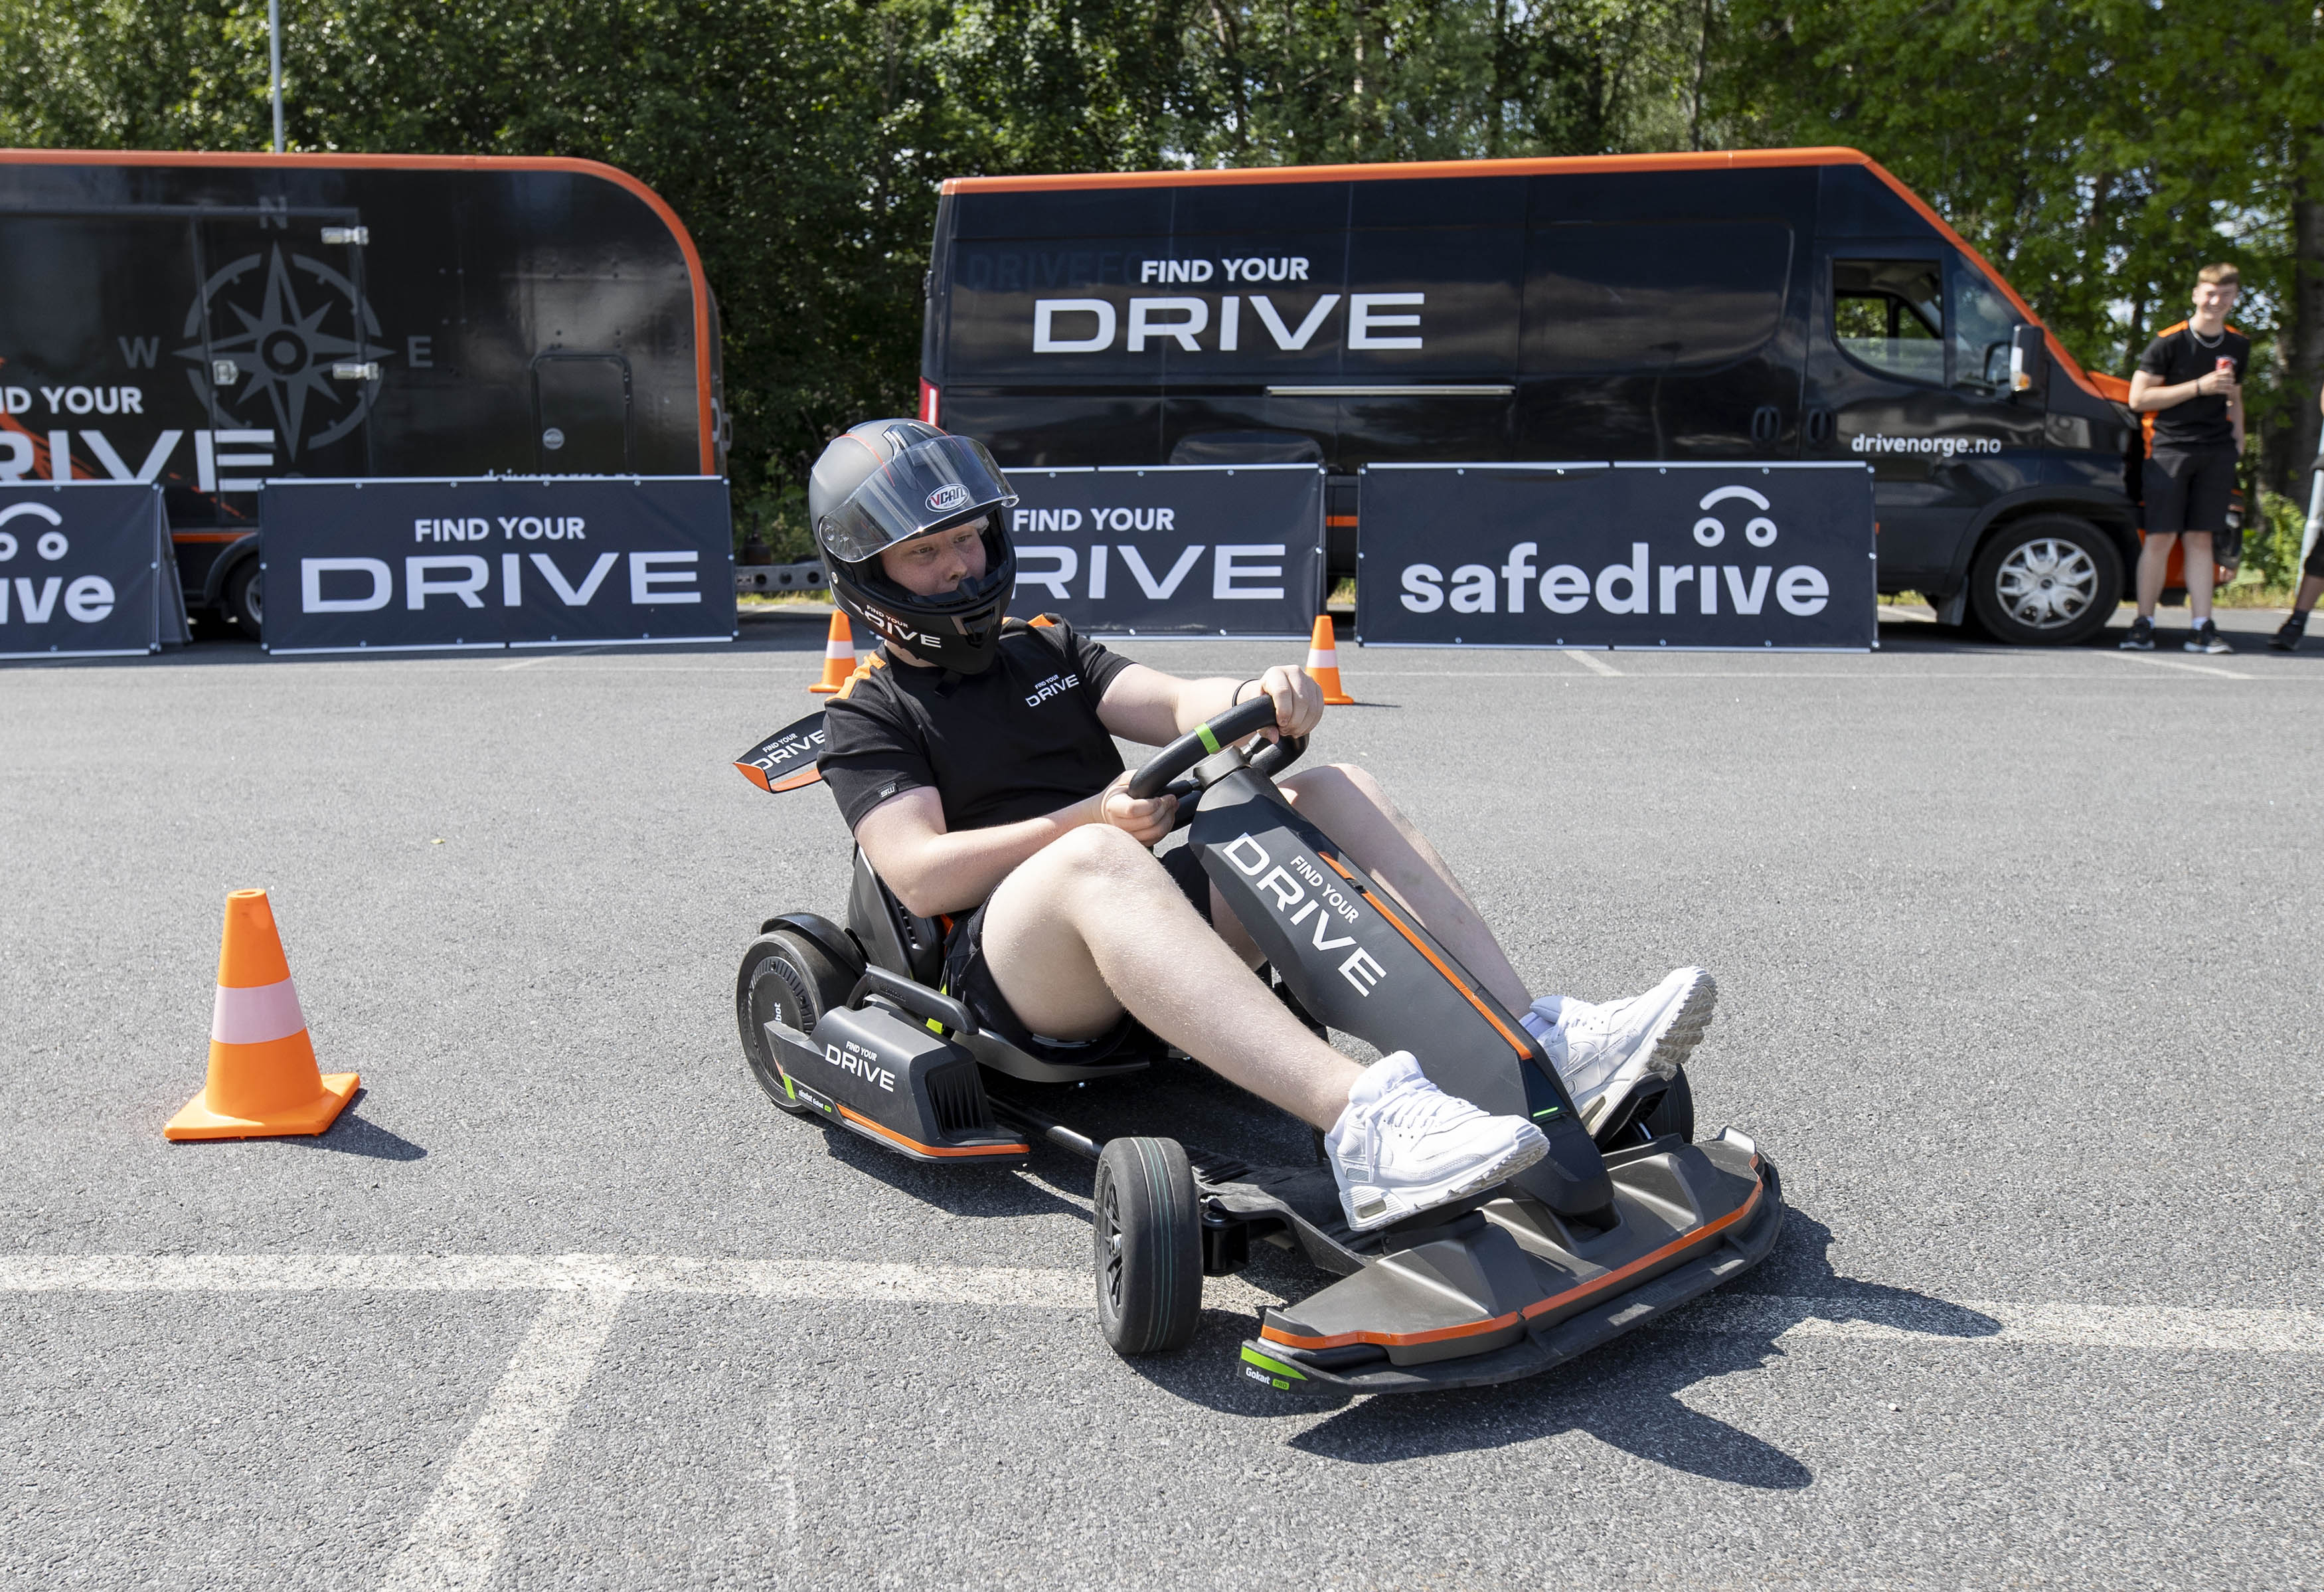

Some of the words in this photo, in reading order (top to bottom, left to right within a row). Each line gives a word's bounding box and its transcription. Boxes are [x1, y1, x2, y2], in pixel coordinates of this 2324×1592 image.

[1141, 260, 1213, 284] FIND
[1222, 257, 1309, 282] YOUR
[1033, 293, 1425, 353] DRIVE
[118, 336, 160, 369] W
[408, 336, 434, 367] E
[0, 387, 31, 414] D
[41, 387, 143, 414] YOUR
[1851, 433, 2001, 458] drivenorge.no
[414, 518, 489, 543] FIND
[497, 517, 586, 540] YOUR
[1013, 509, 1082, 532] FIND
[1090, 507, 1175, 531] YOUR
[301, 551, 702, 613] DRIVE
[1011, 544, 1286, 600] RIVE
[1400, 542, 1829, 616] safedrive
[867, 604, 884, 618] FIND
[886, 615, 909, 628] YOUR
[1025, 673, 1080, 707] DRIVE
[1035, 681, 1046, 689] FIND
[1046, 674, 1060, 684] YOUR
[750, 729, 825, 770] DRIVE
[762, 741, 780, 753] FIND
[778, 733, 798, 745] YOUR
[1290, 855, 1324, 887] FIND
[1321, 883, 1360, 925] YOUR
[1222, 832, 1387, 998] DRIVE
[846, 1040, 861, 1053] FIND
[861, 1047, 878, 1061] YOUR
[825, 1043, 896, 1093] DRIVE
[1246, 1367, 1271, 1385] Gokart
[1274, 1381, 1287, 1389] PRO
